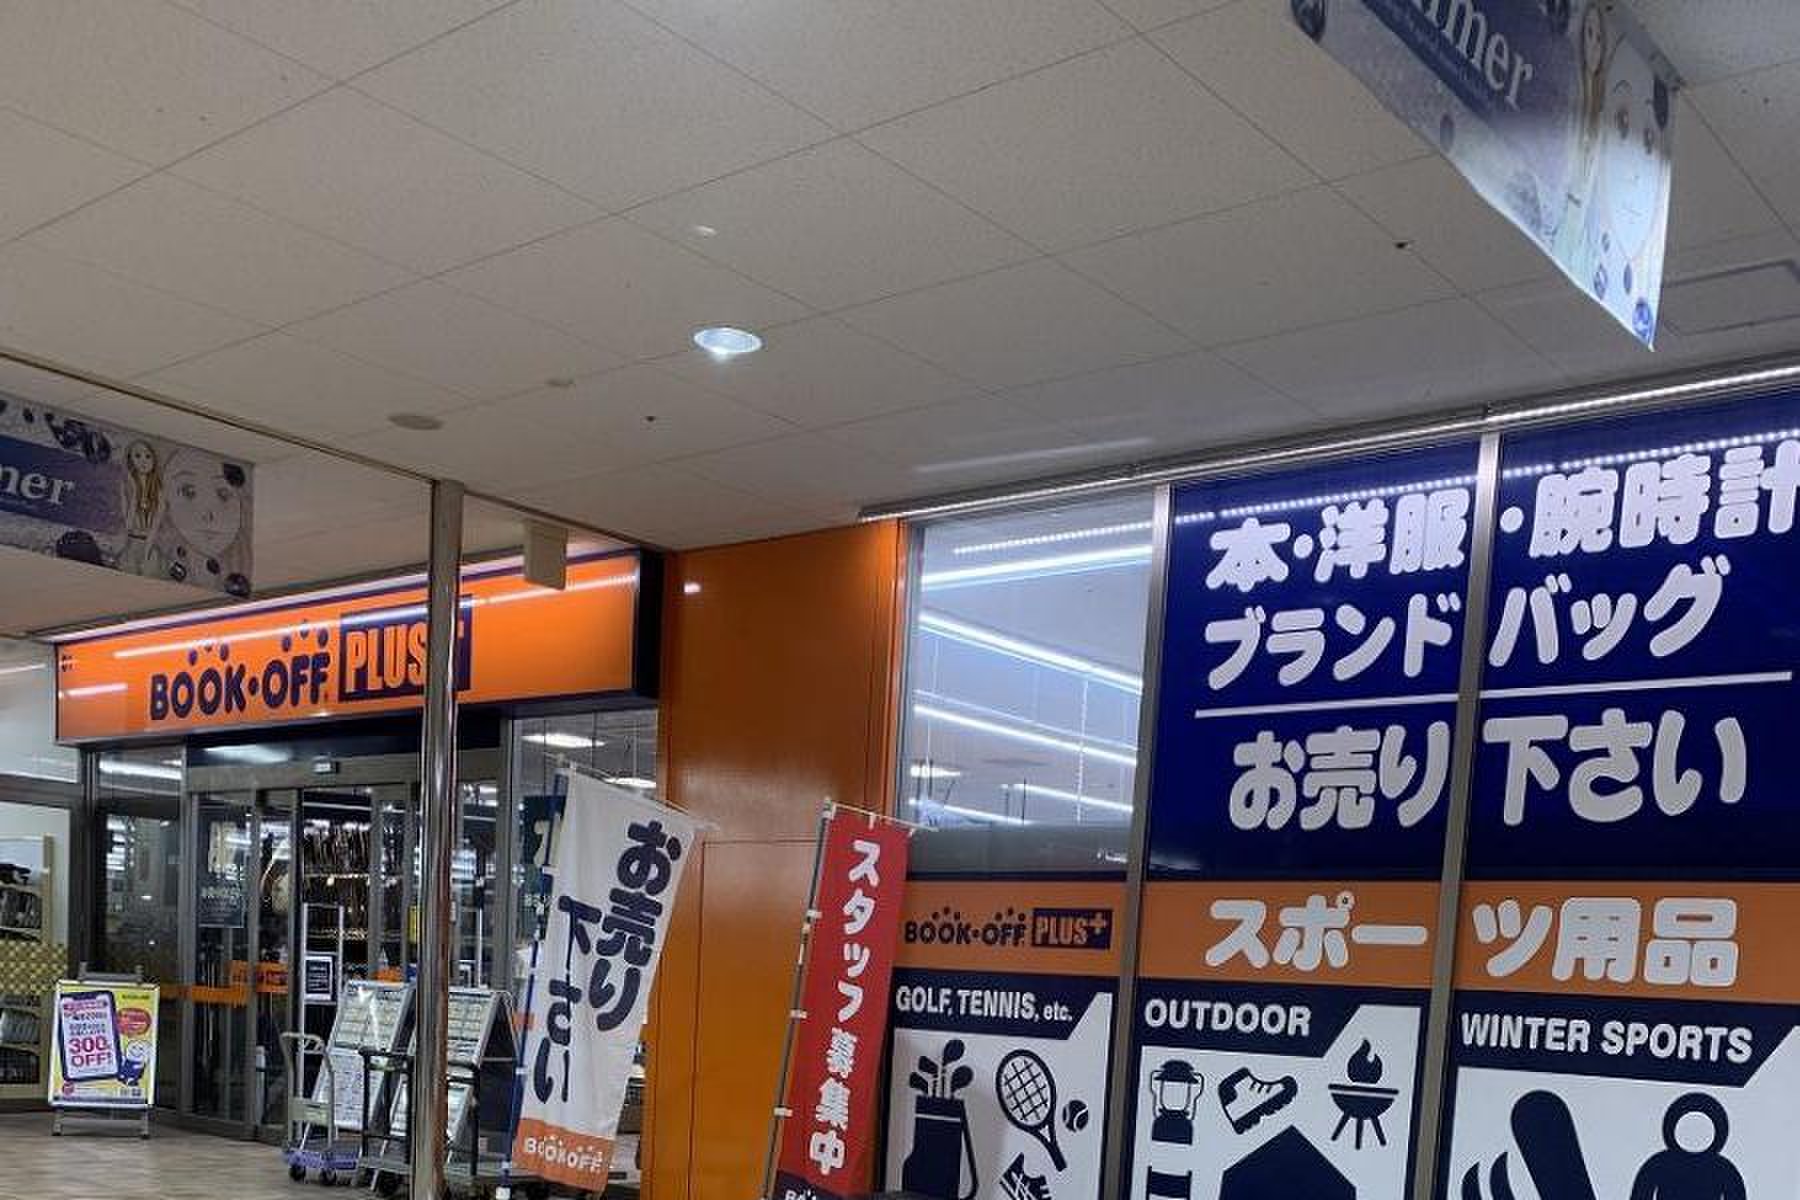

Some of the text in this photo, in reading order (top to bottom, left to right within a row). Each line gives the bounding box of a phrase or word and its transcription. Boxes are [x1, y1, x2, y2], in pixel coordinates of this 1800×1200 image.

[1204, 554, 1731, 690] ブランドバッグ
[1229, 707, 1747, 831] お売り下さい
[1204, 890, 1740, 987] スポーツ用品
[809, 839, 881, 1176] スタッフ募集中
[956, 988, 1039, 1022] TENNIS,
[1042, 1001, 1073, 1022] etc.
[1144, 998, 1312, 1037] OUTDOOR
[1461, 1012, 1753, 1065] WINTER SPORTS
